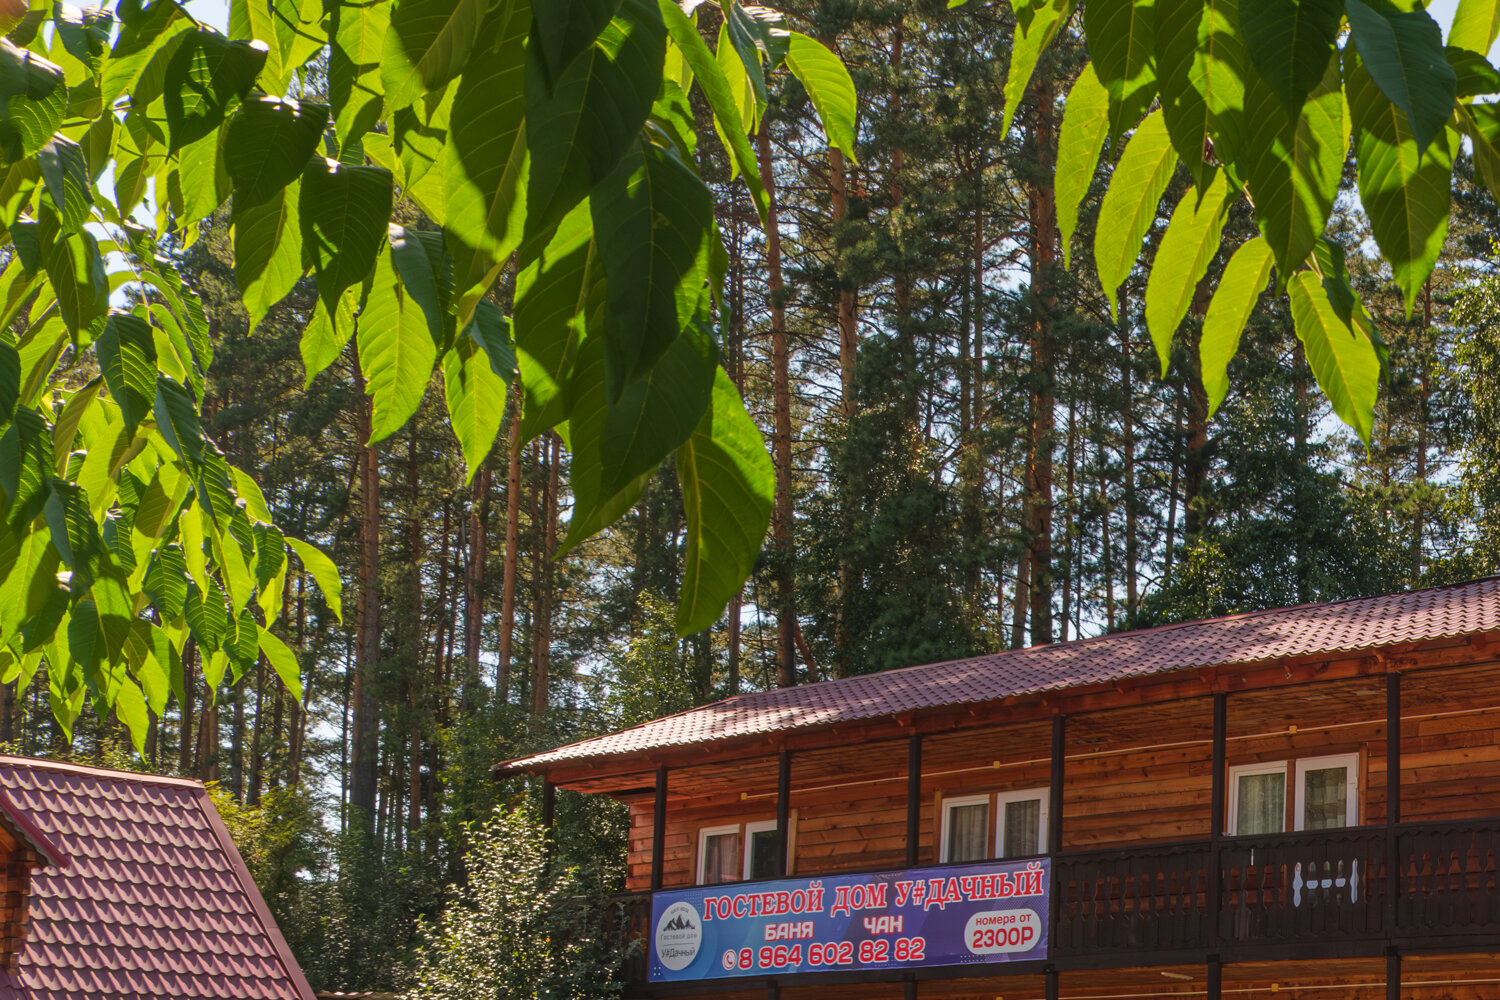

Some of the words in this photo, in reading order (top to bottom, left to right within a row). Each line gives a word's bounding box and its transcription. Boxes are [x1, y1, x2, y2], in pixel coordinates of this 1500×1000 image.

[703, 881, 825, 920] ГОСТЕВОЙ
[831, 883, 888, 917] ДОМ
[895, 862, 1044, 910] У#ДАЧНЫЙ
[764, 921, 814, 942] БАНЯ
[864, 915, 903, 934] ЧАН
[975, 915, 1015, 926] номера
[1019, 914, 1032, 923] от
[972, 926, 1034, 949] 2300Р
[738, 947, 753, 969] 8
[759, 944, 802, 968] 964
[808, 941, 853, 965] 602
[859, 939, 889, 963] 82
[895, 937, 925, 961] 82
